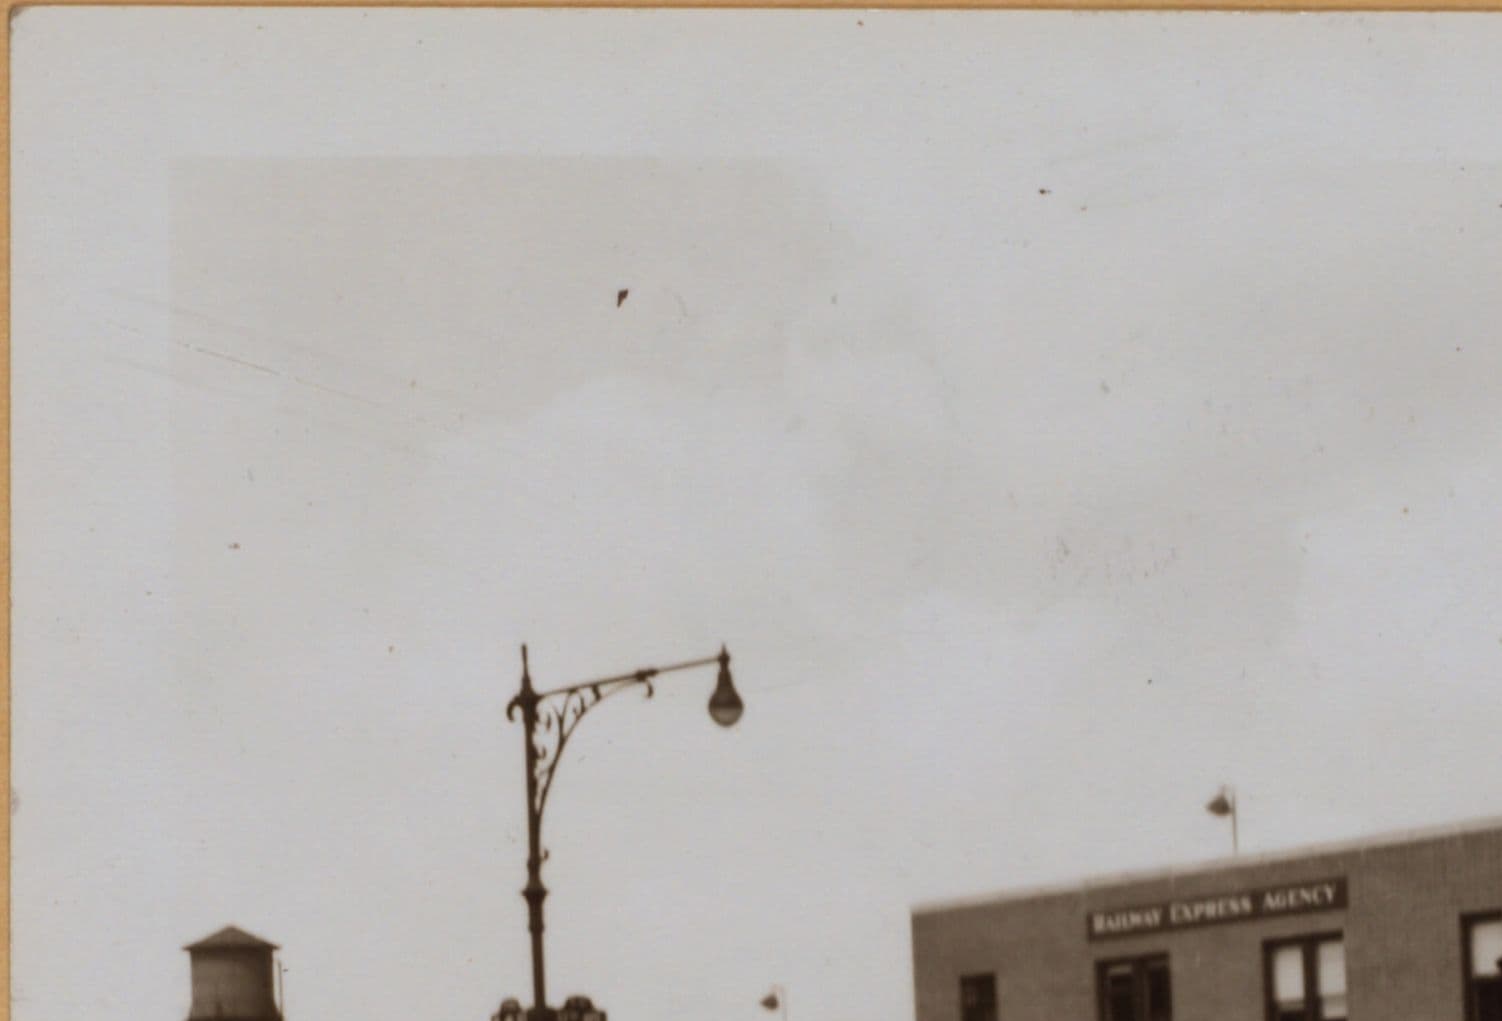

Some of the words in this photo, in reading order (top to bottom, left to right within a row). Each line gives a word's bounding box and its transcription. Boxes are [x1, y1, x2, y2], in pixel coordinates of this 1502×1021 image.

[1092, 908, 1163, 934] RAILWAY
[1169, 896, 1253, 923] EXPRESS
[1262, 884, 1337, 910] AGENCY
